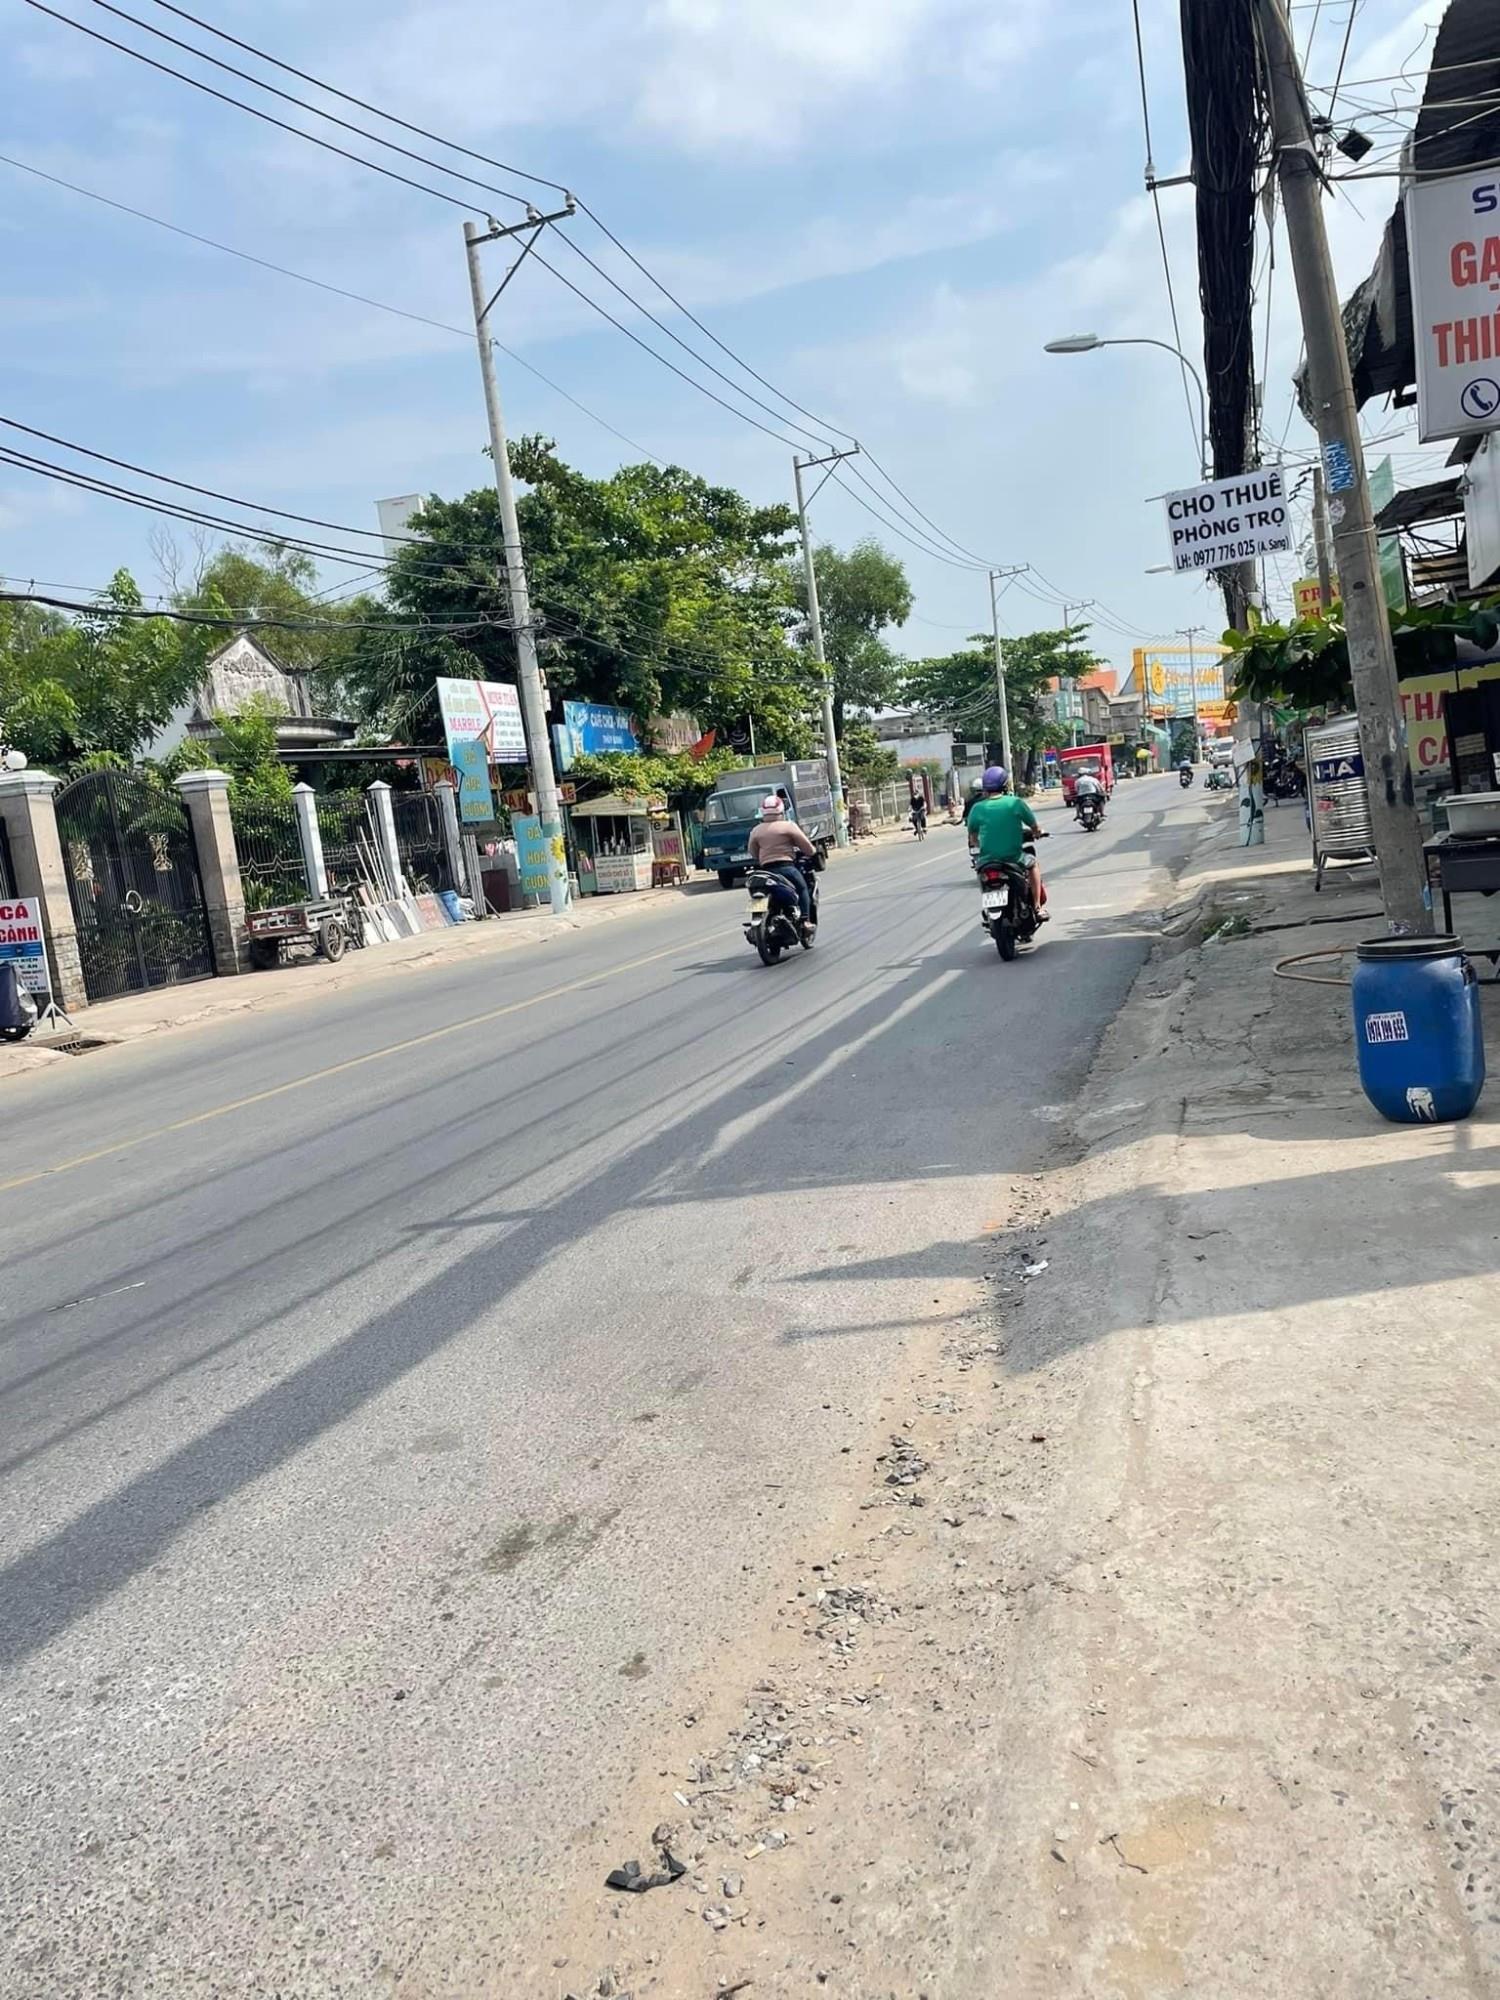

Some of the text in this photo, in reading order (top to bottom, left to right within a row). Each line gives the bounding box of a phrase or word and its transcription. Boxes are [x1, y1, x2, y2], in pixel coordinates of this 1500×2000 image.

[1472, 183, 1500, 214] S
[1168, 472, 1282, 520] CHO THUÊ
[1172, 507, 1285, 546] PHÒNG TRỌ
[1176, 553, 1192, 570] LH:
[1193, 547, 1215, 566] 0977
[1218, 543, 1236, 561] 776
[1237, 539, 1256, 557] 025
[1399, 689, 1449, 721] THA
[1418, 735, 1450, 767] CA
[0, 902, 29, 920] CÁ
